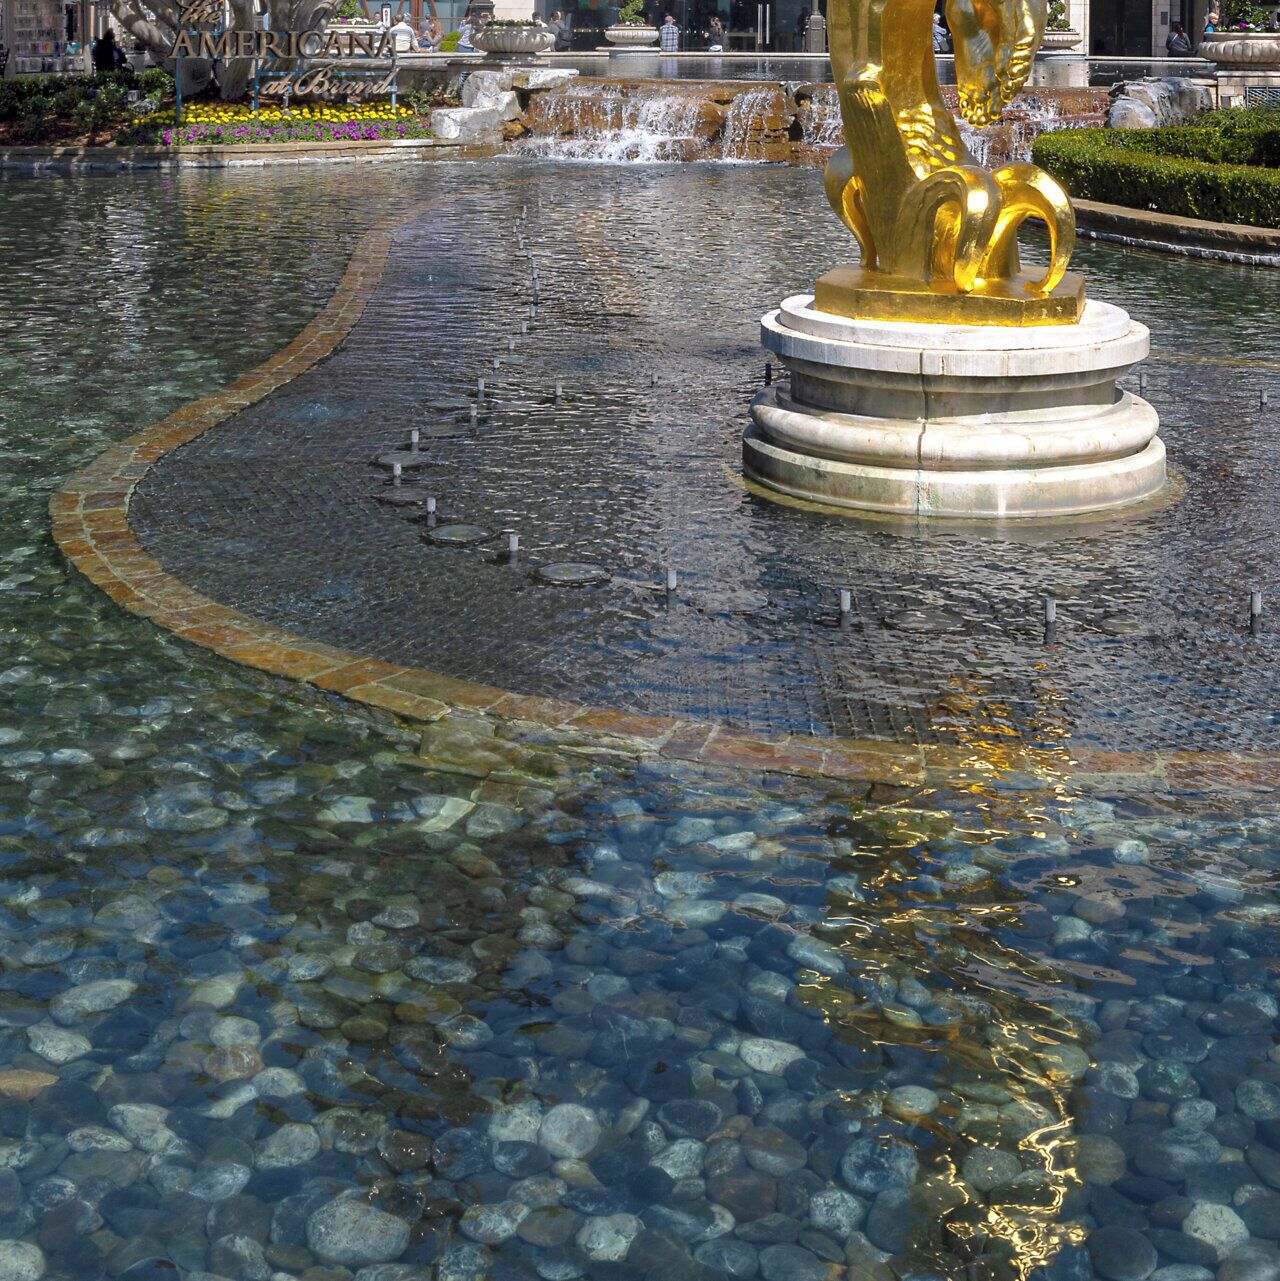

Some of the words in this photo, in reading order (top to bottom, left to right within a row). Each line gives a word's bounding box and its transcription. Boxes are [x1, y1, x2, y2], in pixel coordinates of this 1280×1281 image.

[170, 29, 399, 60] AMERICANA
[261, 72, 294, 95] at
[293, 63, 401, 96] Brand
